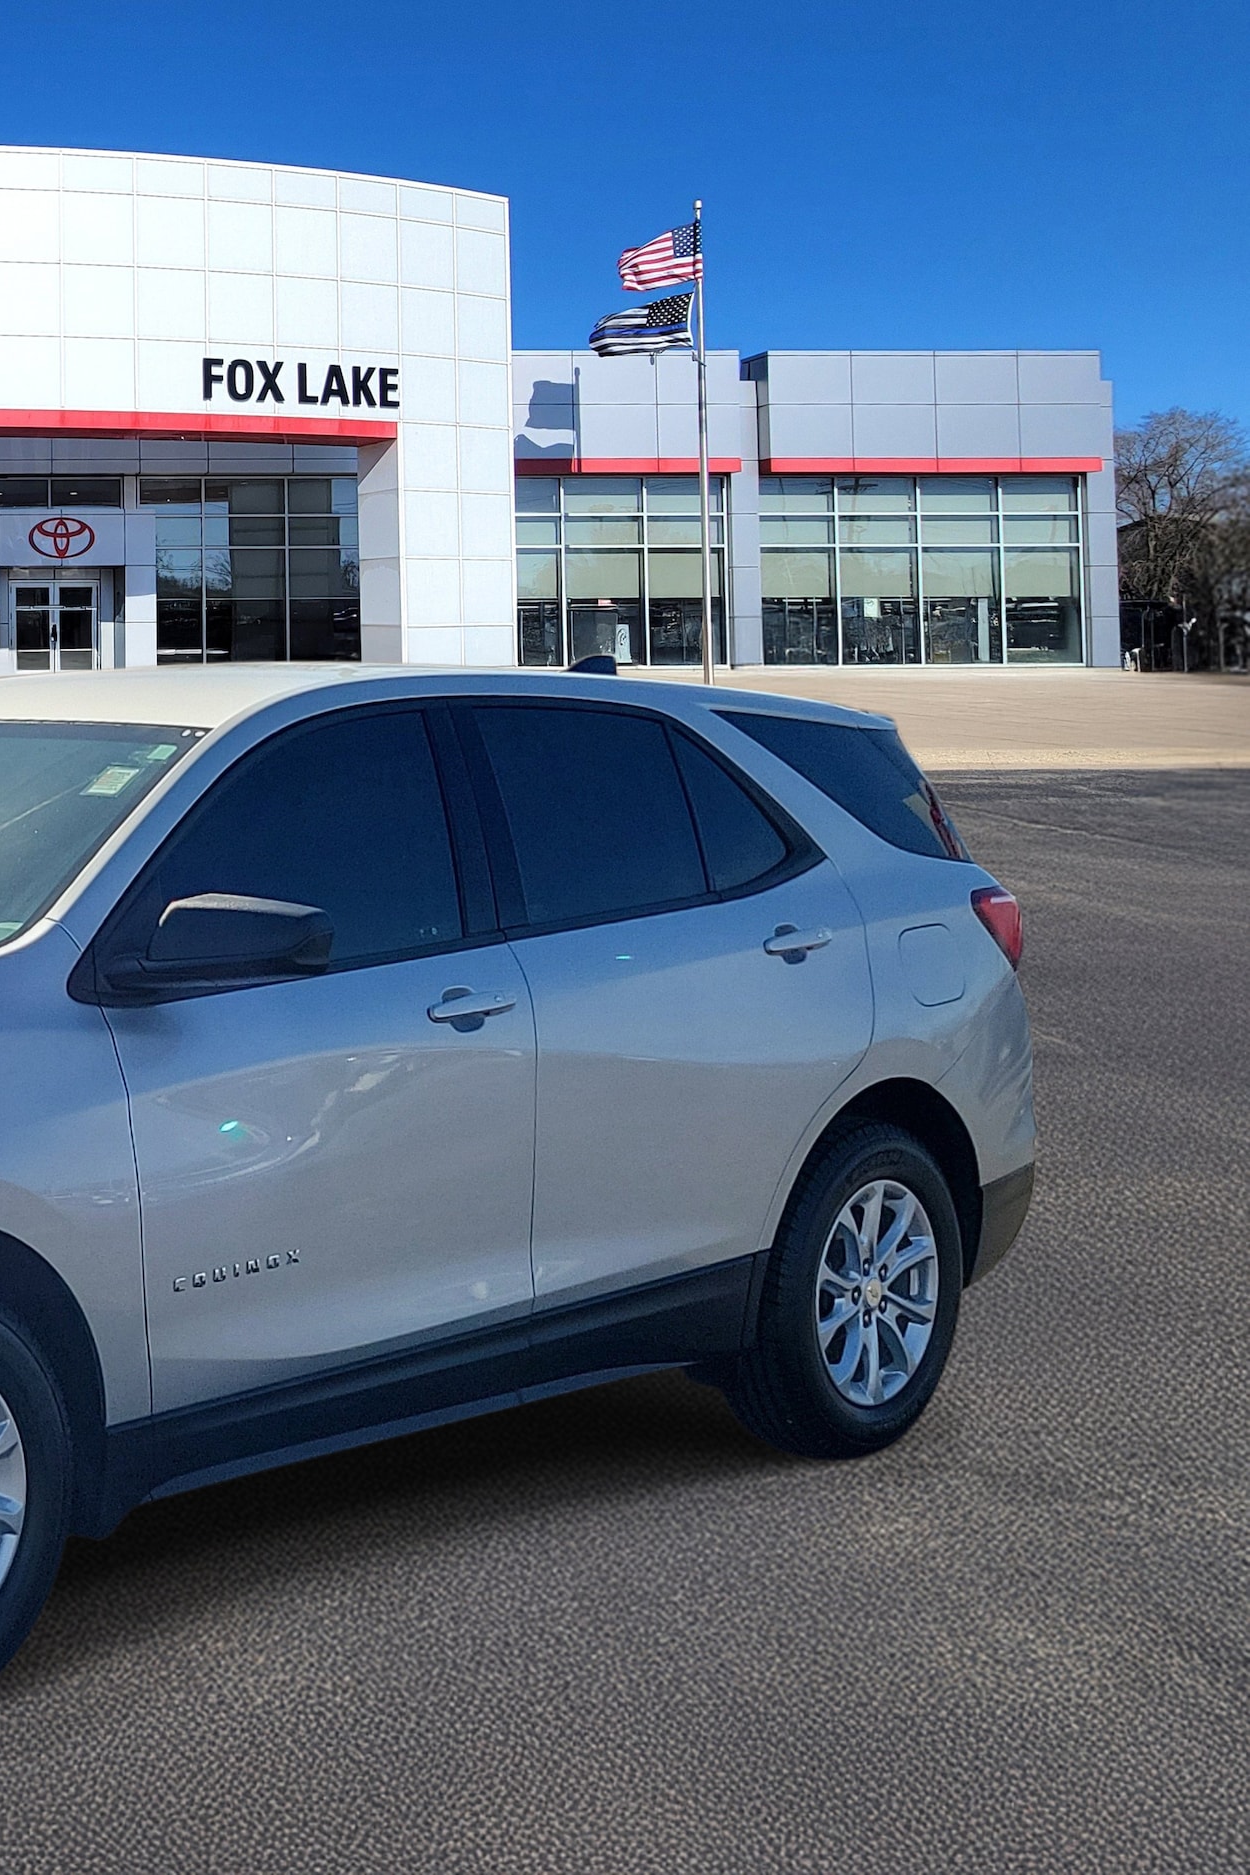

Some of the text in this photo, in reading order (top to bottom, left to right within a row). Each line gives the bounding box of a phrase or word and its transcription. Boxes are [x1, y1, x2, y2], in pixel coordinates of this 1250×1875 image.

[203, 357, 400, 408] FOX LAKE
[173, 1248, 300, 1292] EQUINOX
